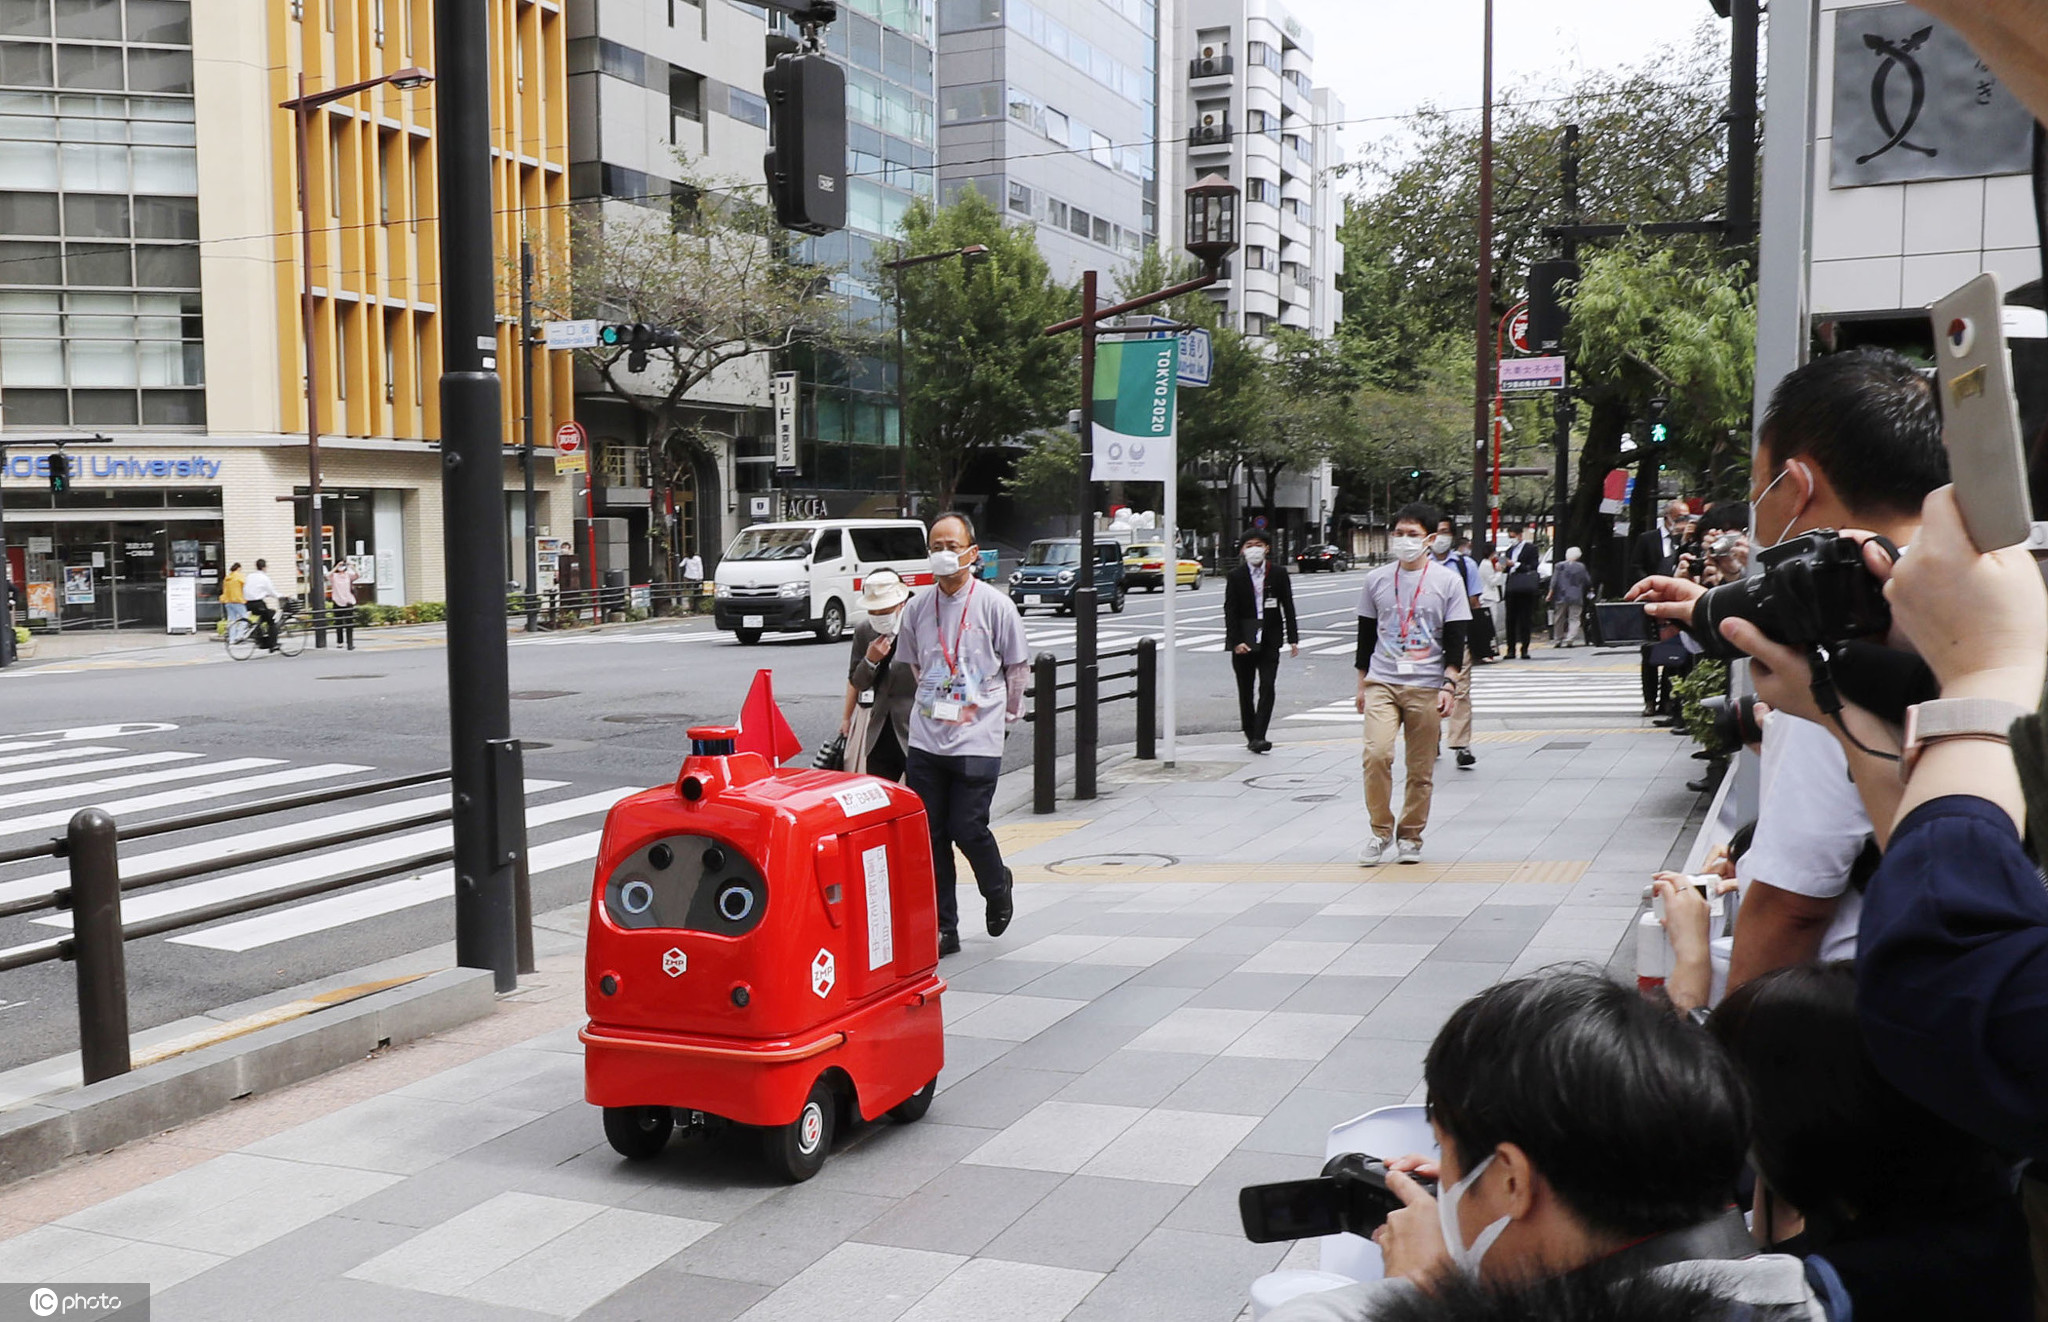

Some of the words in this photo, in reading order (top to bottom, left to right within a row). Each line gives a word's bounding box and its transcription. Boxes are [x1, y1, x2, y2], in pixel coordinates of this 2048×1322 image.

[1155, 349, 1171, 396] TOKYO
[1151, 398, 1167, 433] 2020
[92, 455, 222, 478] University
[788, 499, 828, 517] ACCEA
[814, 966, 833, 981] ZMP
